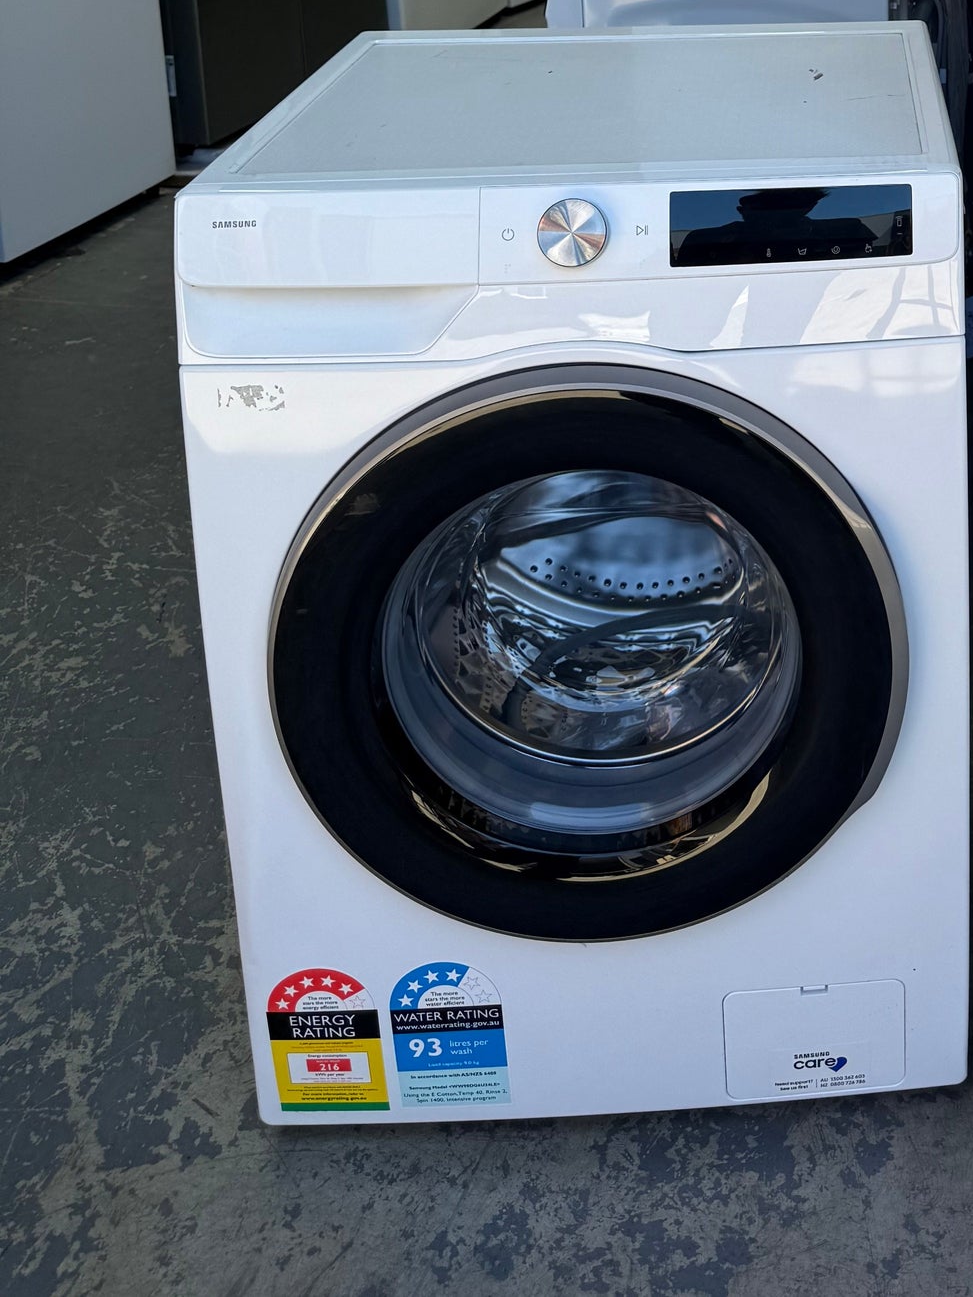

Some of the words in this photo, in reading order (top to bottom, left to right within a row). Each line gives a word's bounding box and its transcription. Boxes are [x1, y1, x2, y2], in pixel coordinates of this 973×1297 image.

[212, 220, 257, 228] SAMSUNG
[289, 1015, 356, 1026] ENERGY
[394, 1012, 442, 1022] WATER
[447, 1009, 499, 1020] RATING
[396, 1021, 500, 1031] www.waterrating.gov.au
[292, 1027, 356, 1038] RATING
[409, 1038, 443, 1058] 93
[474, 1040, 488, 1048] per
[794, 1051, 830, 1059] SAMSUNG
[794, 1058, 836, 1070] care
